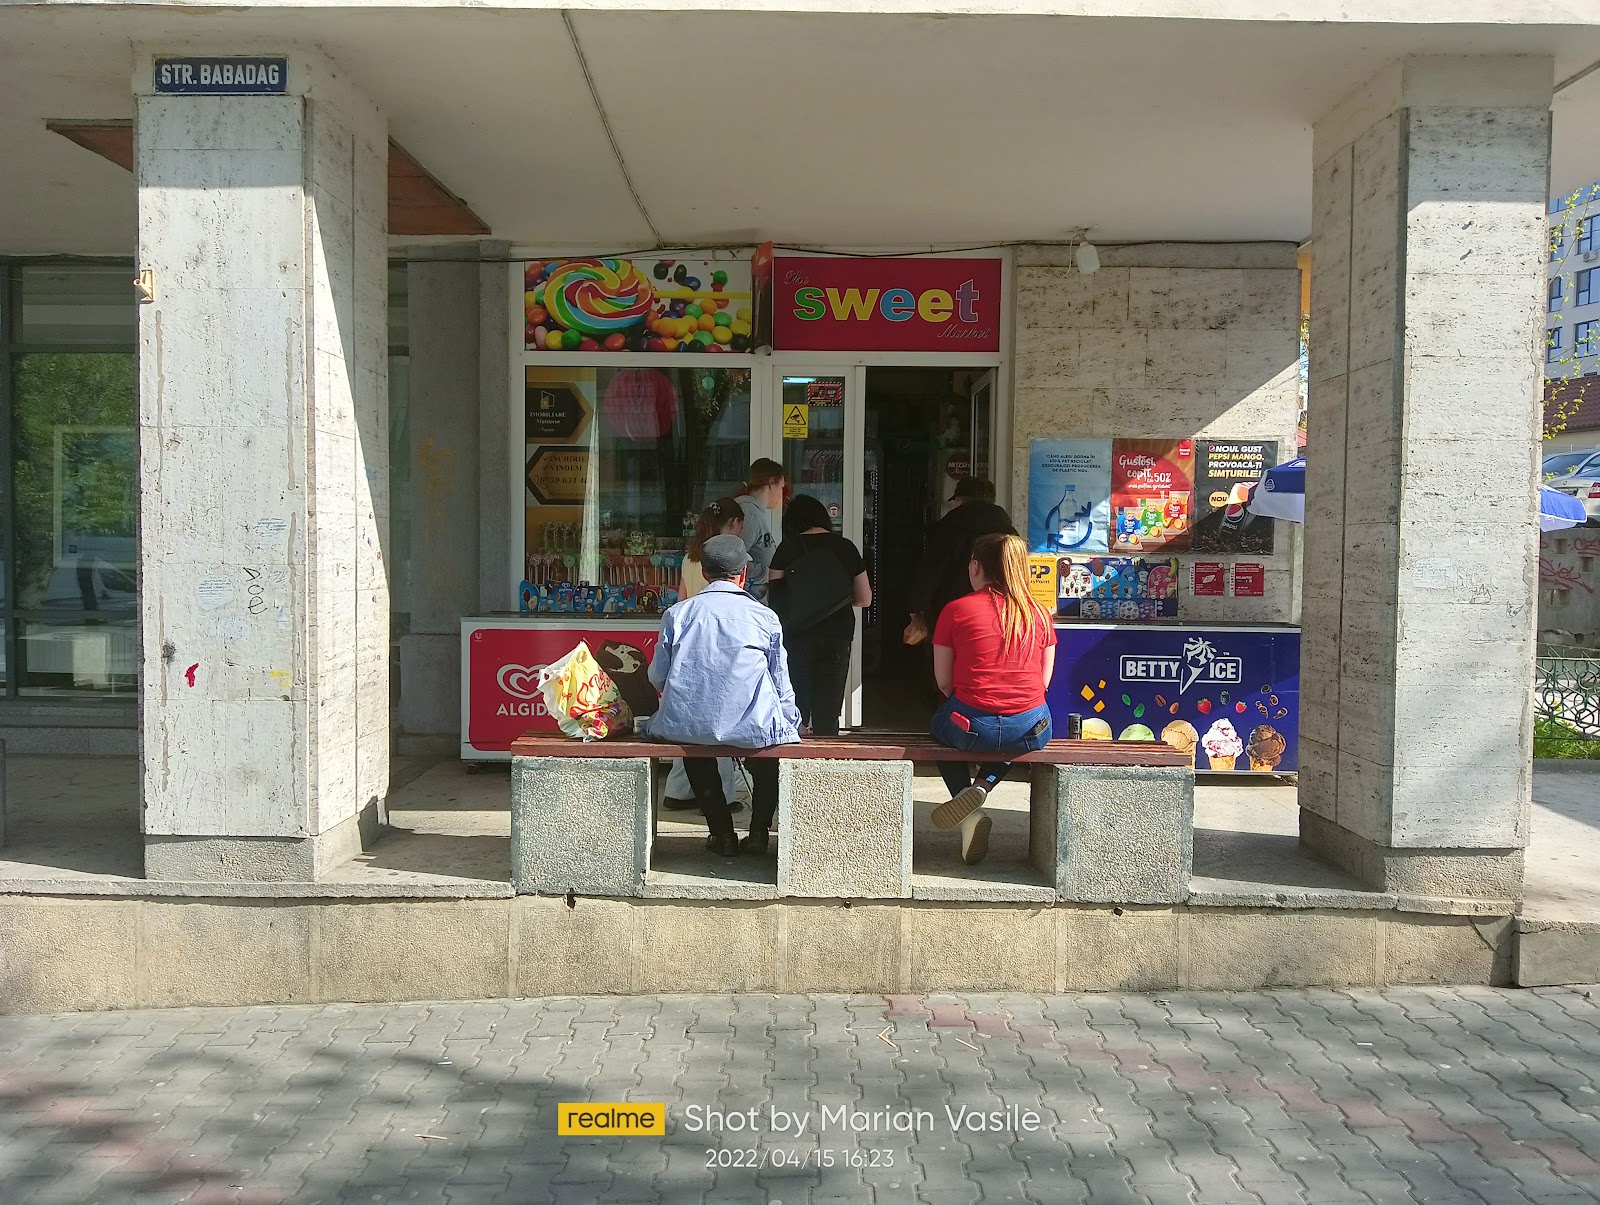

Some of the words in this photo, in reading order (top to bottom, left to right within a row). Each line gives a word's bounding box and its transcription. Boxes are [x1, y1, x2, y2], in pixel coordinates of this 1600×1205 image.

[161, 64, 198, 85] STR.
[200, 64, 279, 85] BABADAG
[783, 269, 810, 285] The
[793, 278, 979, 323] sweet
[937, 323, 990, 339] Market
[1215, 445, 1240, 453] NOUL
[1241, 445, 1263, 453] GUST
[1231, 453, 1265, 461] MANGO.
[1154, 472, 1172, 483] 50%
[1125, 660, 1180, 678] BETTY
[1209, 661, 1237, 679] ICE
[496, 702, 551, 716] ALGID
